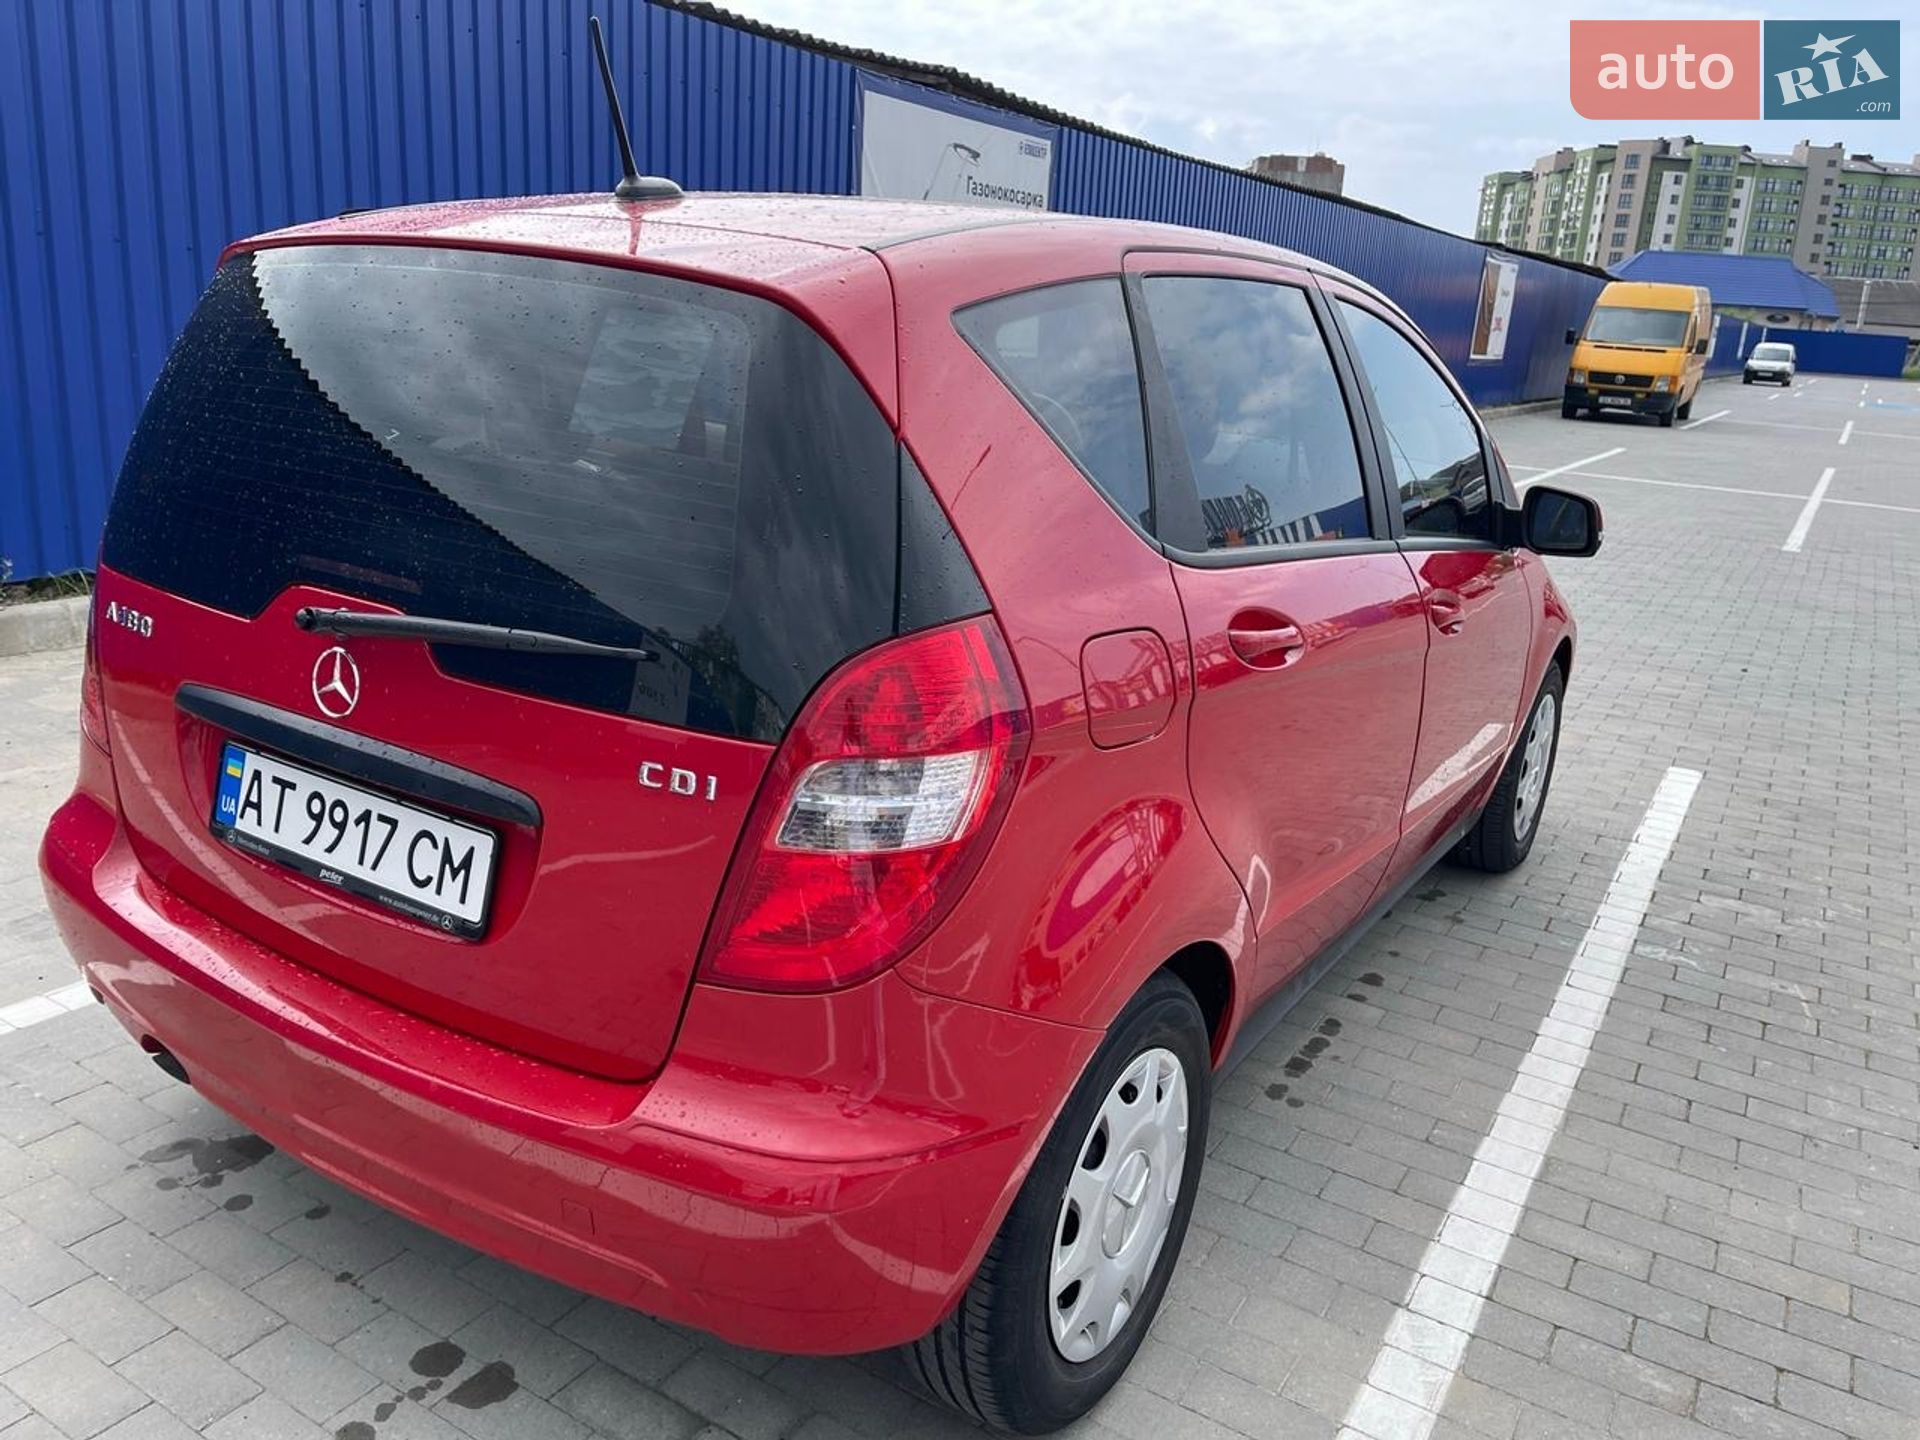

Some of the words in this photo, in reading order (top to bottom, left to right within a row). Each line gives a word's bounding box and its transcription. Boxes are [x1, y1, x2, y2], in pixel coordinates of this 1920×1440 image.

[966, 175, 1044, 210] Газонокосарка
[638, 761, 718, 801] CDI
[221, 796, 237, 815] UA
[239, 769, 297, 834] AT
[301, 790, 399, 872] 9917
[407, 829, 476, 905] CM
